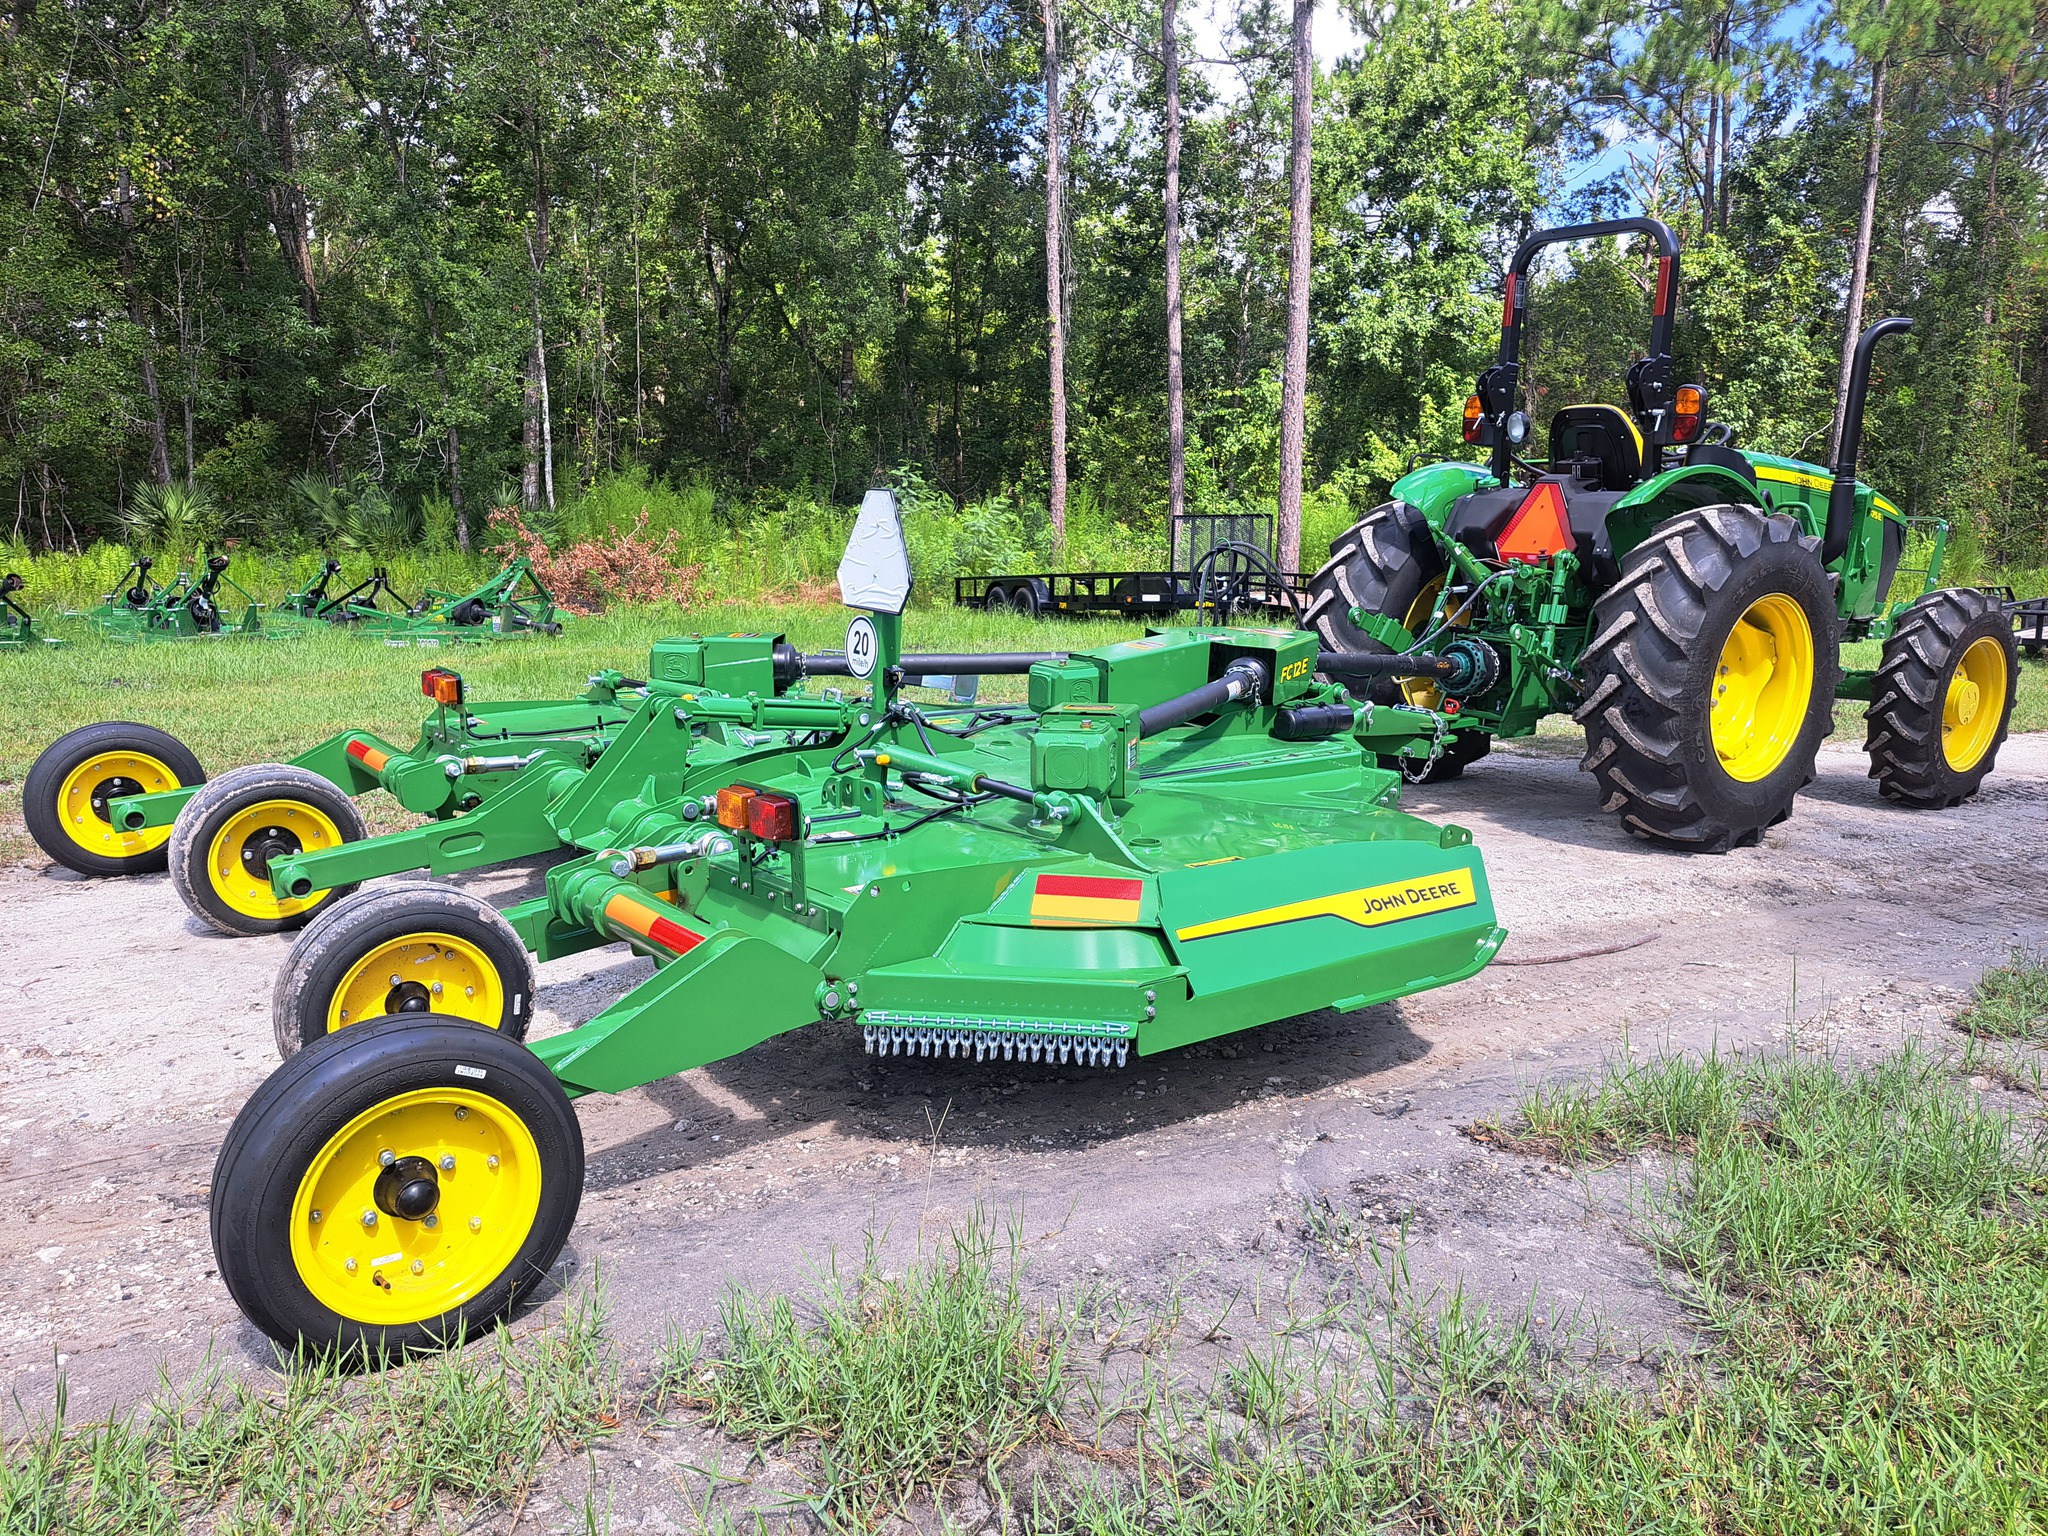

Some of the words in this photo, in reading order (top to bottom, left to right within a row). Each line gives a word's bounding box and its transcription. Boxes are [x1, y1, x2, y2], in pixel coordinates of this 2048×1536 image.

[1792, 474, 1813, 487] JOHN
[1813, 478, 1832, 490] DEER
[853, 630, 869, 657] 20
[1363, 893, 1407, 914] JOHN
[1405, 882, 1461, 904] DEERE
